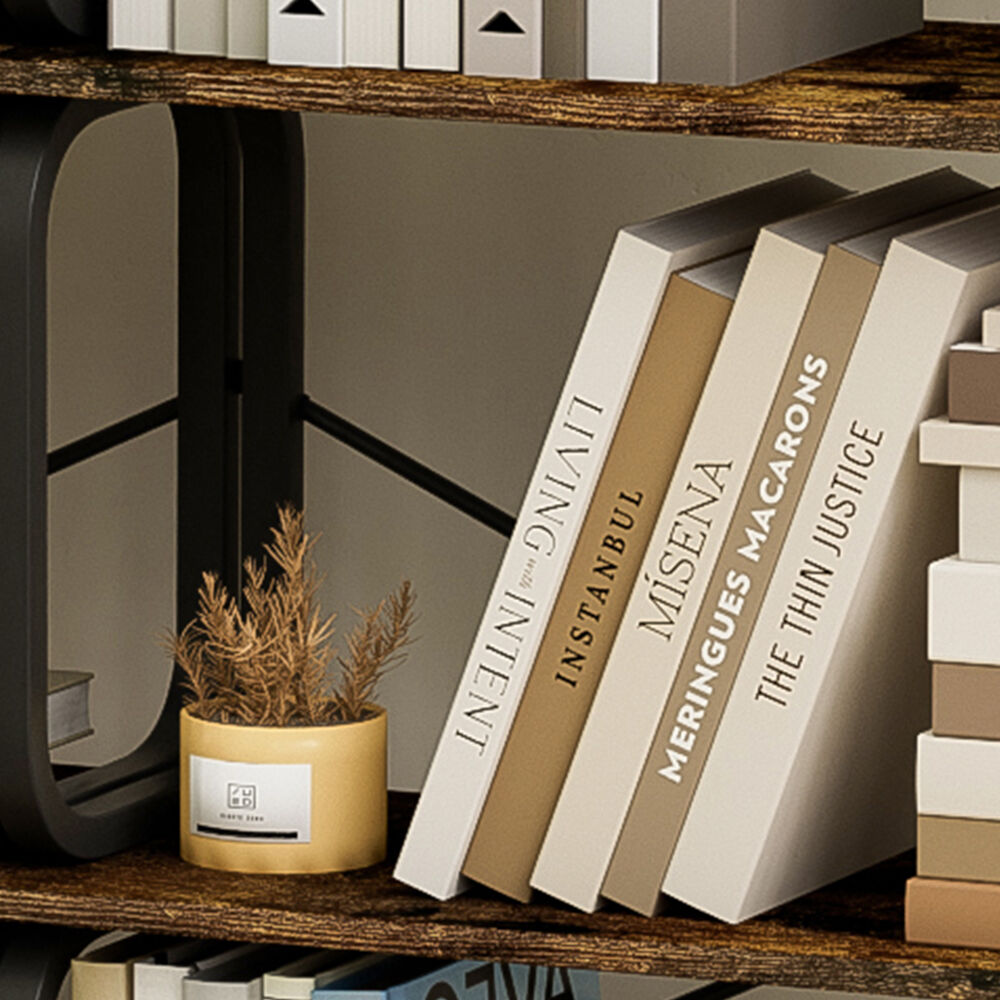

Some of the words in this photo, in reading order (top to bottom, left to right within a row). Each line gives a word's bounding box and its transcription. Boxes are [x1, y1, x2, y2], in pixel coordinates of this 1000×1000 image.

[523, 396, 603, 557] LIVING
[637, 460, 733, 642] MÍSENA
[755, 643, 804, 707] THE
[780, 558, 834, 636] THIN
[812, 420, 884, 557] JUSTICE
[519, 558, 537, 590] with
[555, 490, 644, 688] INSTANBUL
[658, 570, 750, 783] MERINGUES
[737, 353, 828, 562] MACARONS
[456, 591, 535, 757] INTENT
